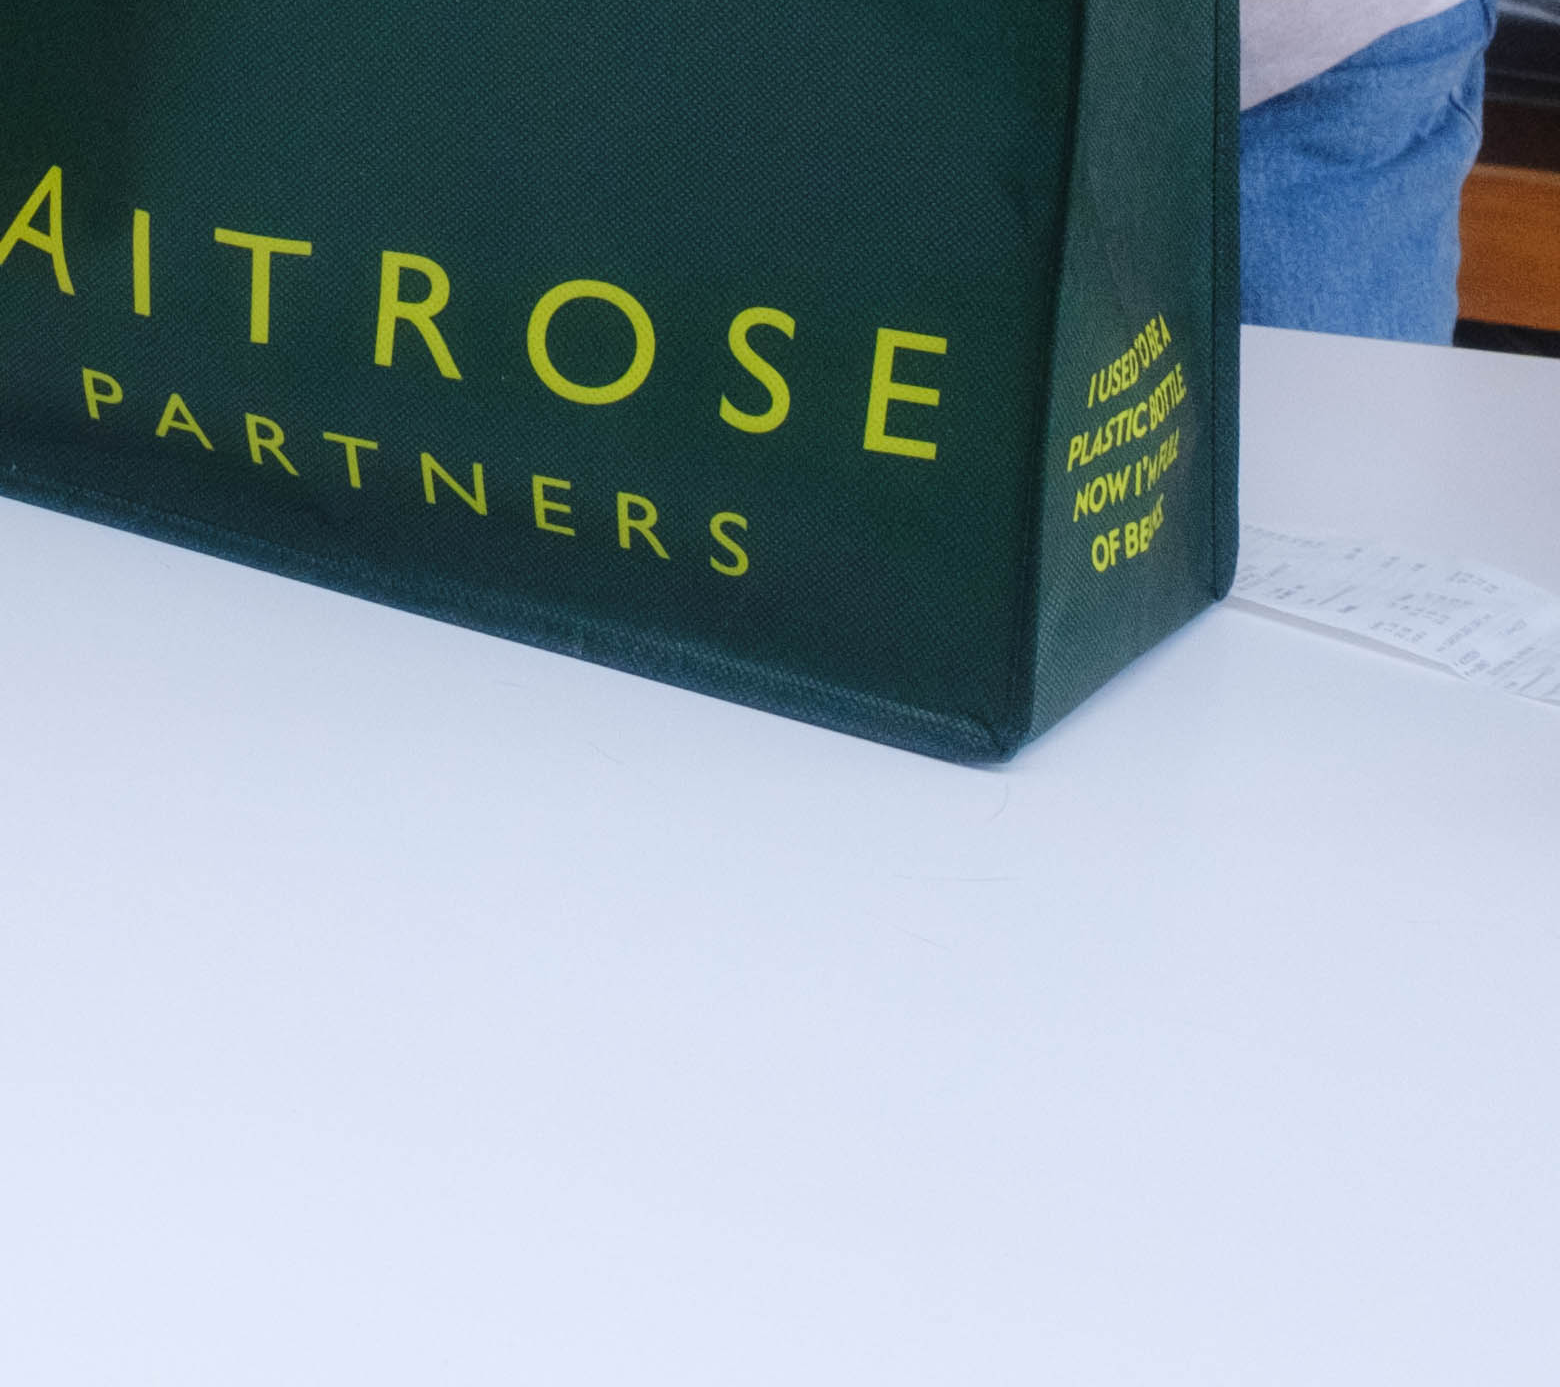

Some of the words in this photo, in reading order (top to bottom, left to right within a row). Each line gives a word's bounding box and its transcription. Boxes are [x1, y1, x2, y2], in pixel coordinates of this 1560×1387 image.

[1087, 373, 1097, 408] I
[1099, 348, 1139, 403] USED
[1134, 332, 1150, 369] O
[1145, 317, 1164, 360] BE
[1158, 311, 1172, 347] A
[83, 367, 750, 577] PARTNERS
[1067, 402, 1147, 472] PLASTIC
[1072, 464, 1131, 523] NOW
[1091, 528, 1120, 573] OF
